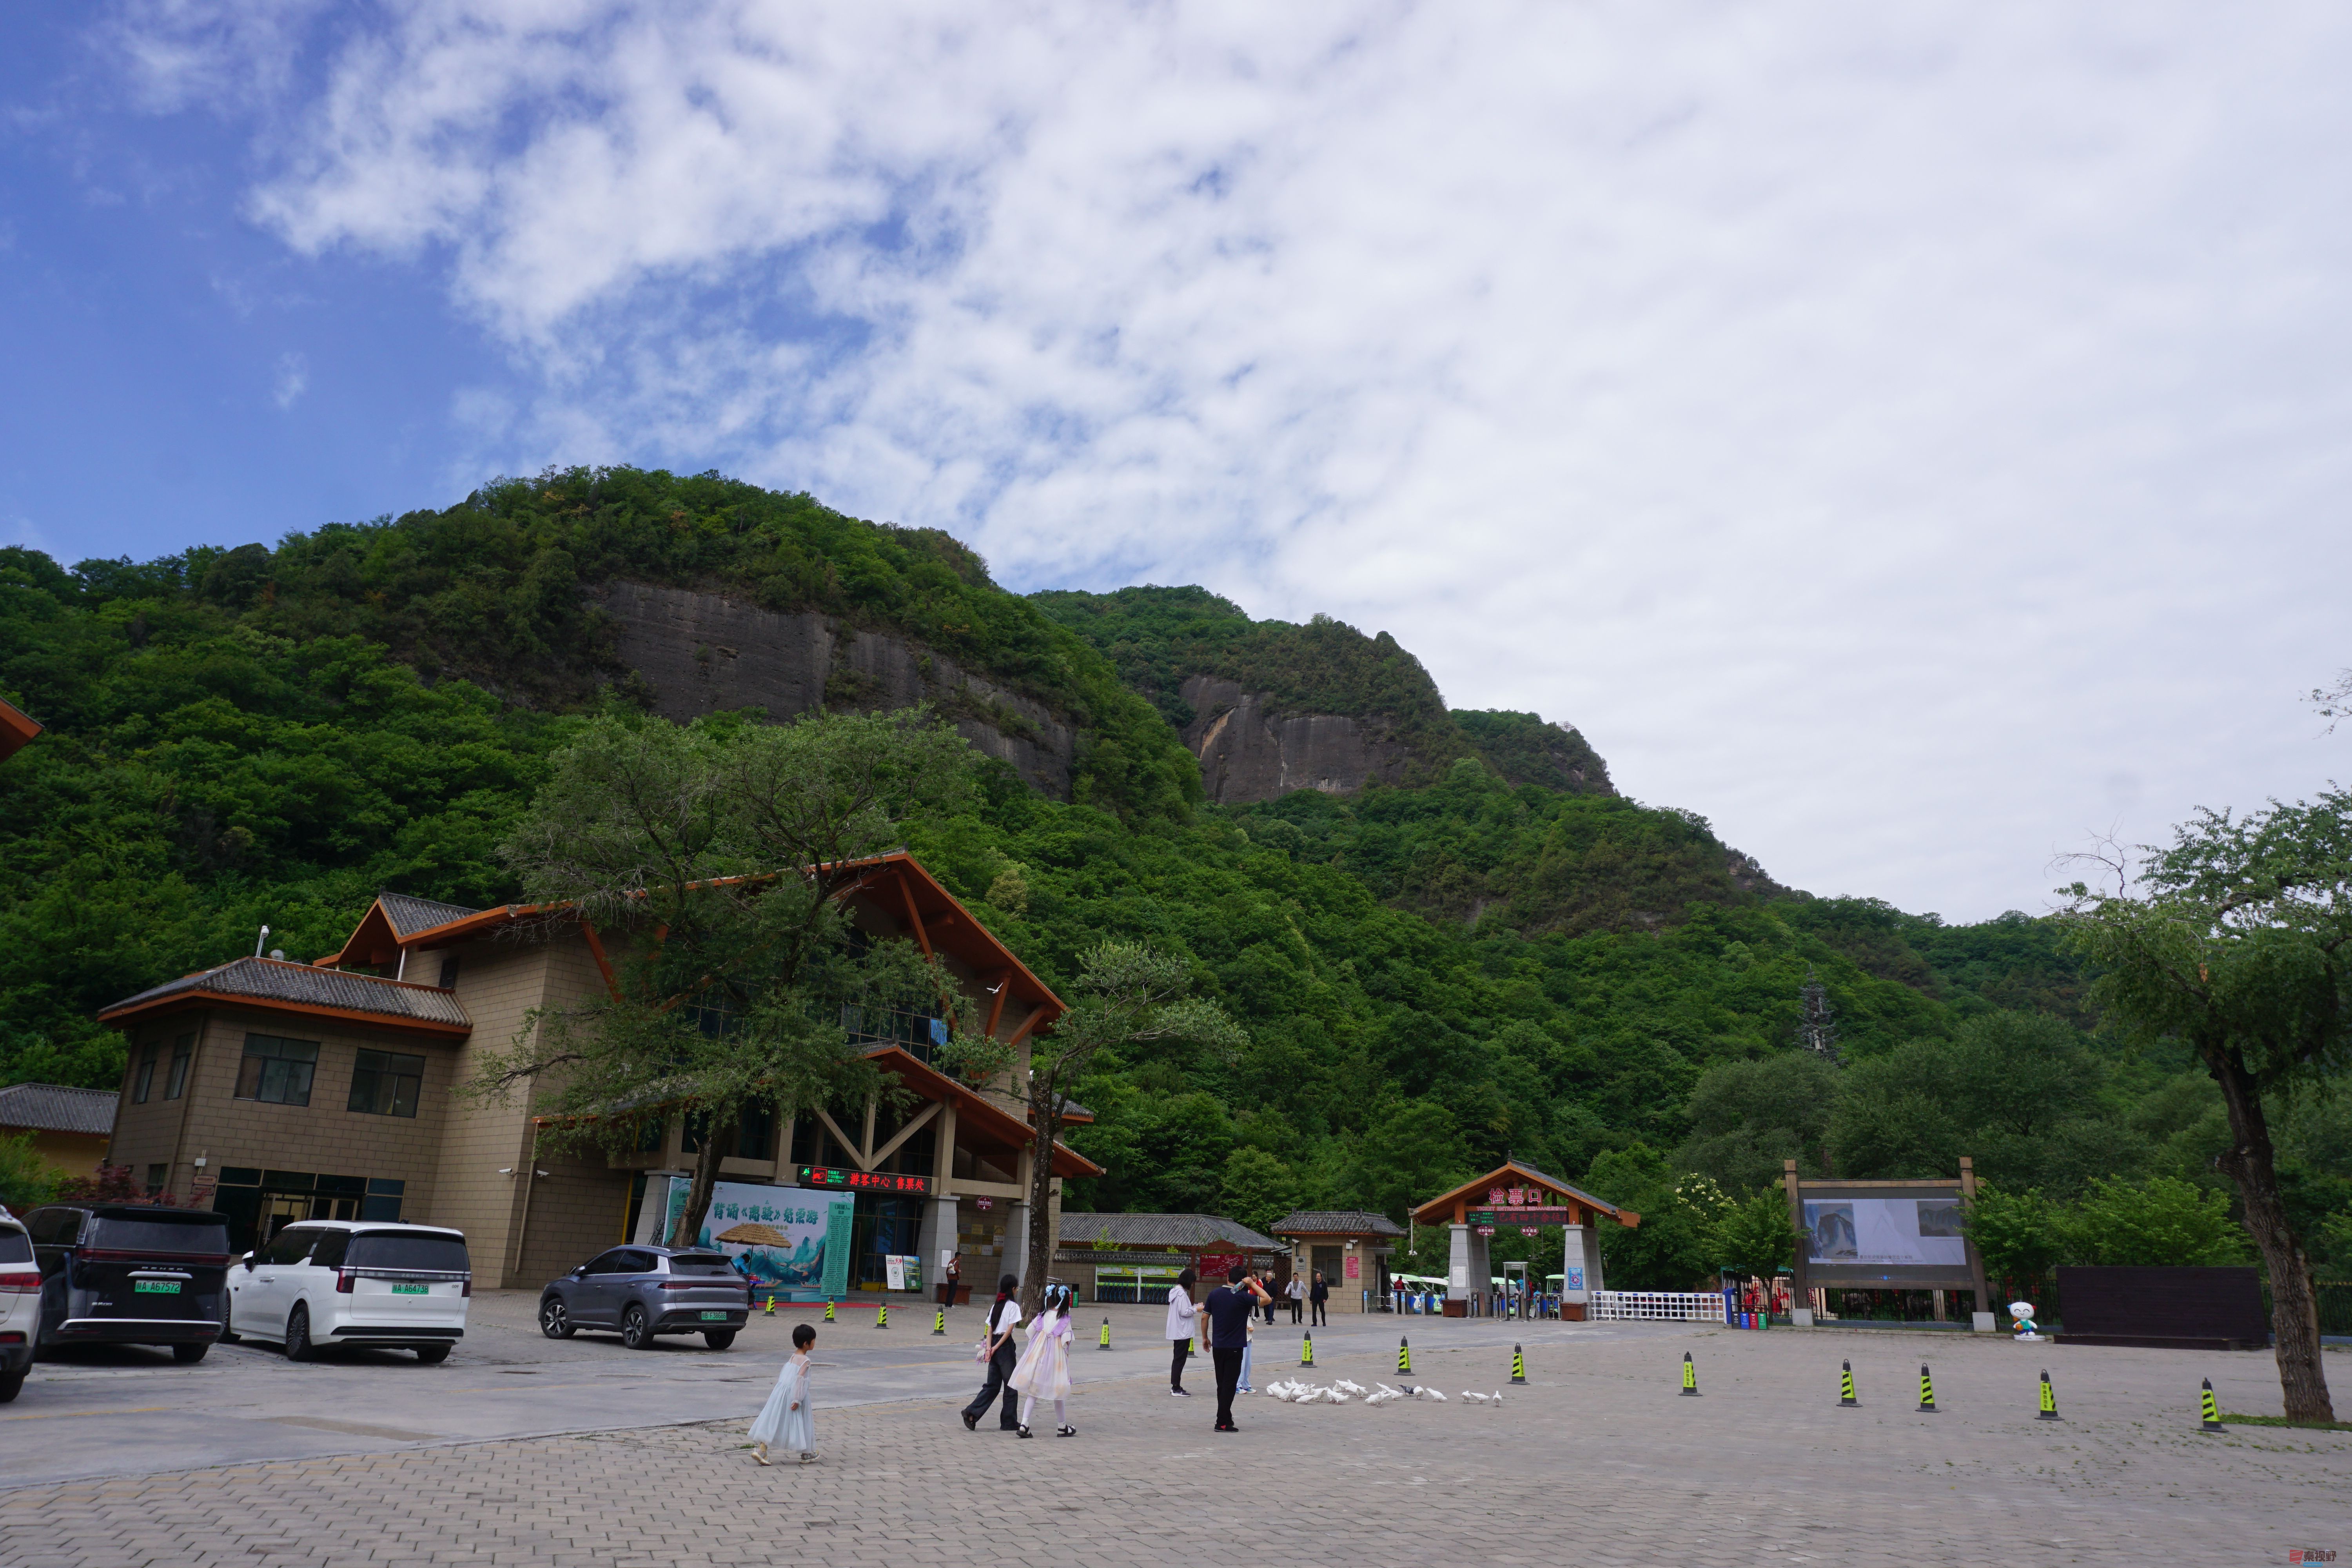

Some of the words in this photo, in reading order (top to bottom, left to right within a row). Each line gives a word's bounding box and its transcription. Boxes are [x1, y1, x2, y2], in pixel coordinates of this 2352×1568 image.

[850, 1172, 890, 1187] 游客中心
[896, 1177, 924, 1191] 售票处
[1489, 1188, 1541, 1205] 检票口
[713, 1202, 819, 1225] 背诵《离骚》免票游
[151, 1282, 180, 1292] A67572
[405, 1285, 428, 1293] A64738
